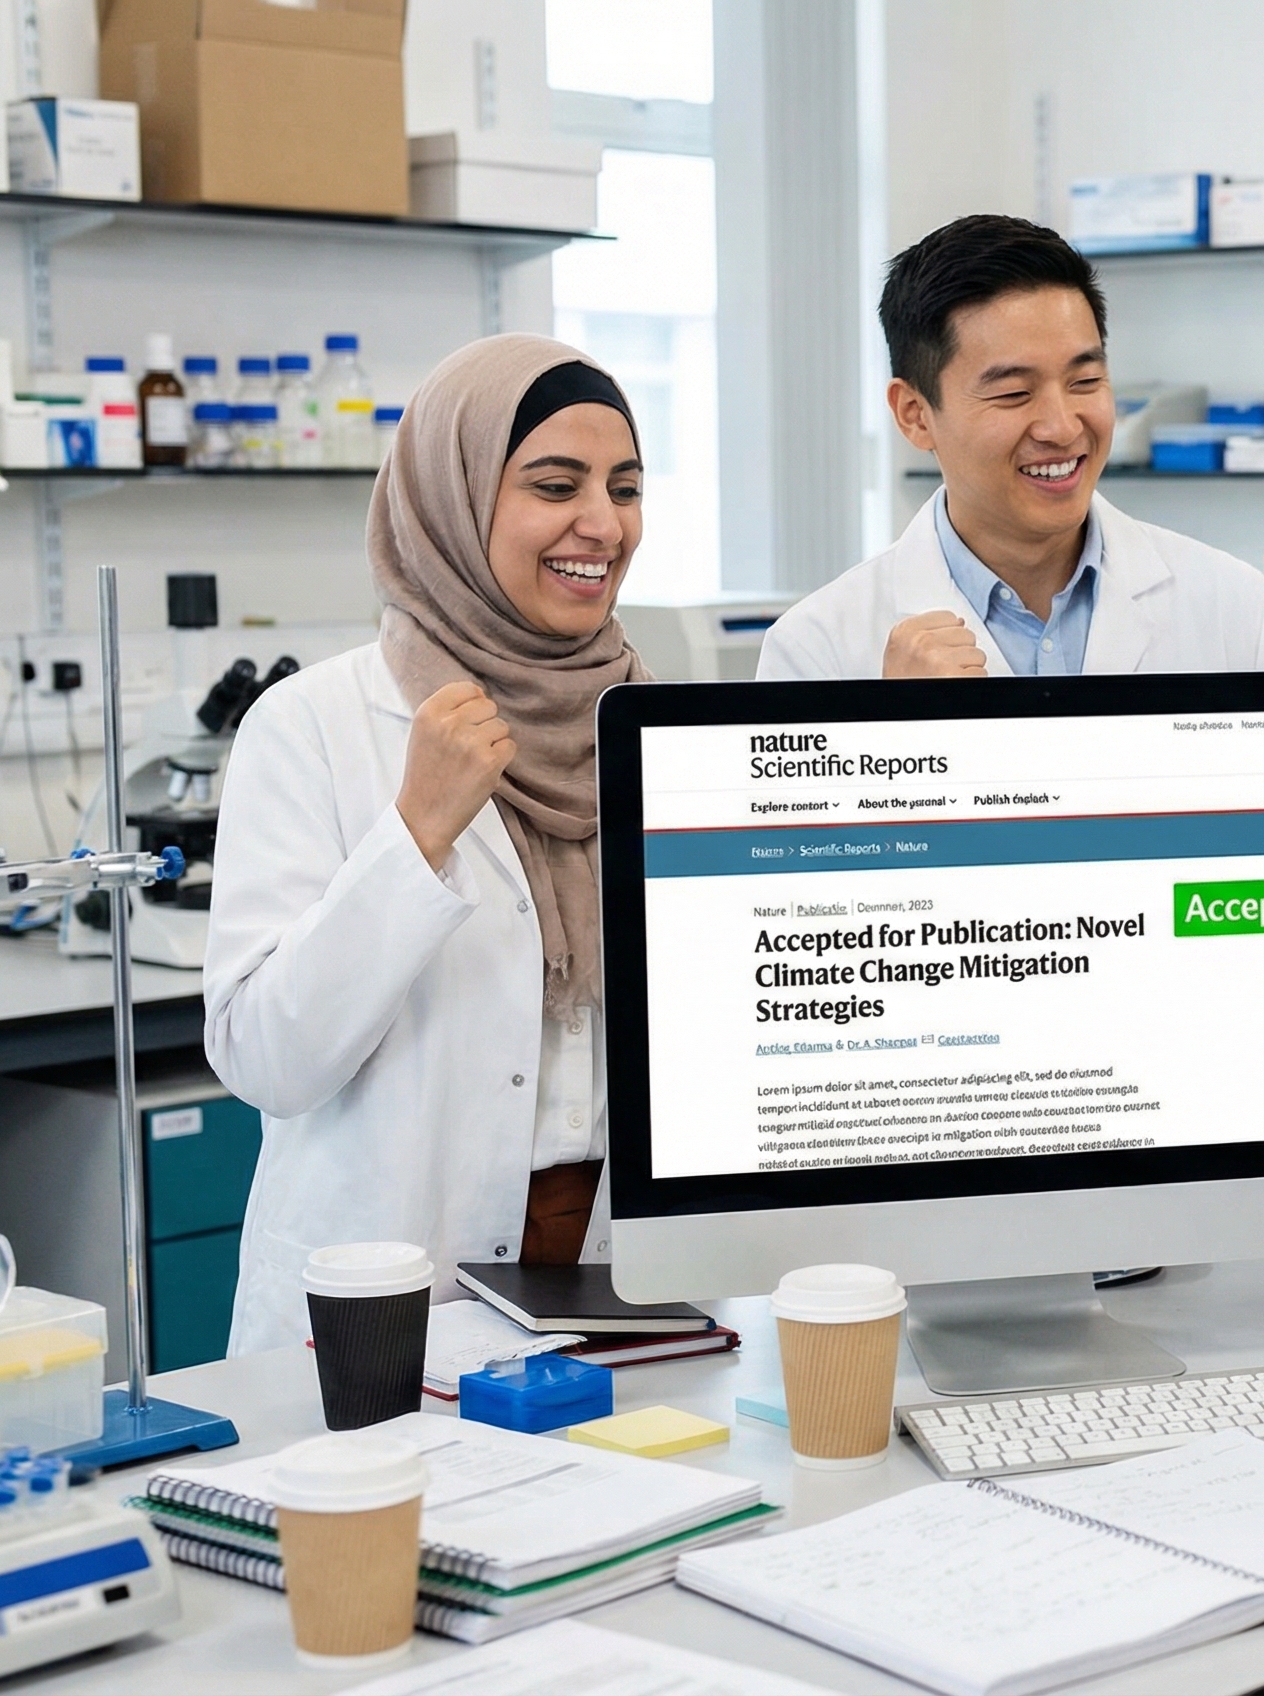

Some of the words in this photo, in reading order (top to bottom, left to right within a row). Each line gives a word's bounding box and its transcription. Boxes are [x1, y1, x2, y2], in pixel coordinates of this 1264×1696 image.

[750, 732, 827, 752] nature
[750, 754, 854, 778] Scientific
[860, 754, 948, 780] Reports
[896, 841, 928, 852] Nature
[754, 907, 786, 917] Nature
[754, 926, 874, 956] Accepted
[879, 924, 915, 948] for
[921, 918, 1072, 946] Publication:
[1077, 913, 1145, 938] Novel
[755, 962, 854, 988] Climate
[860, 958, 954, 986] Change
[959, 951, 1090, 982] Mitigation
[756, 994, 885, 1024] Strategies
[836, 1039, 844, 1050] &
[758, 1086, 789, 1096] Lorem
[792, 1084, 823, 1096] ipsum
[1054, 1069, 1067, 1079] do
